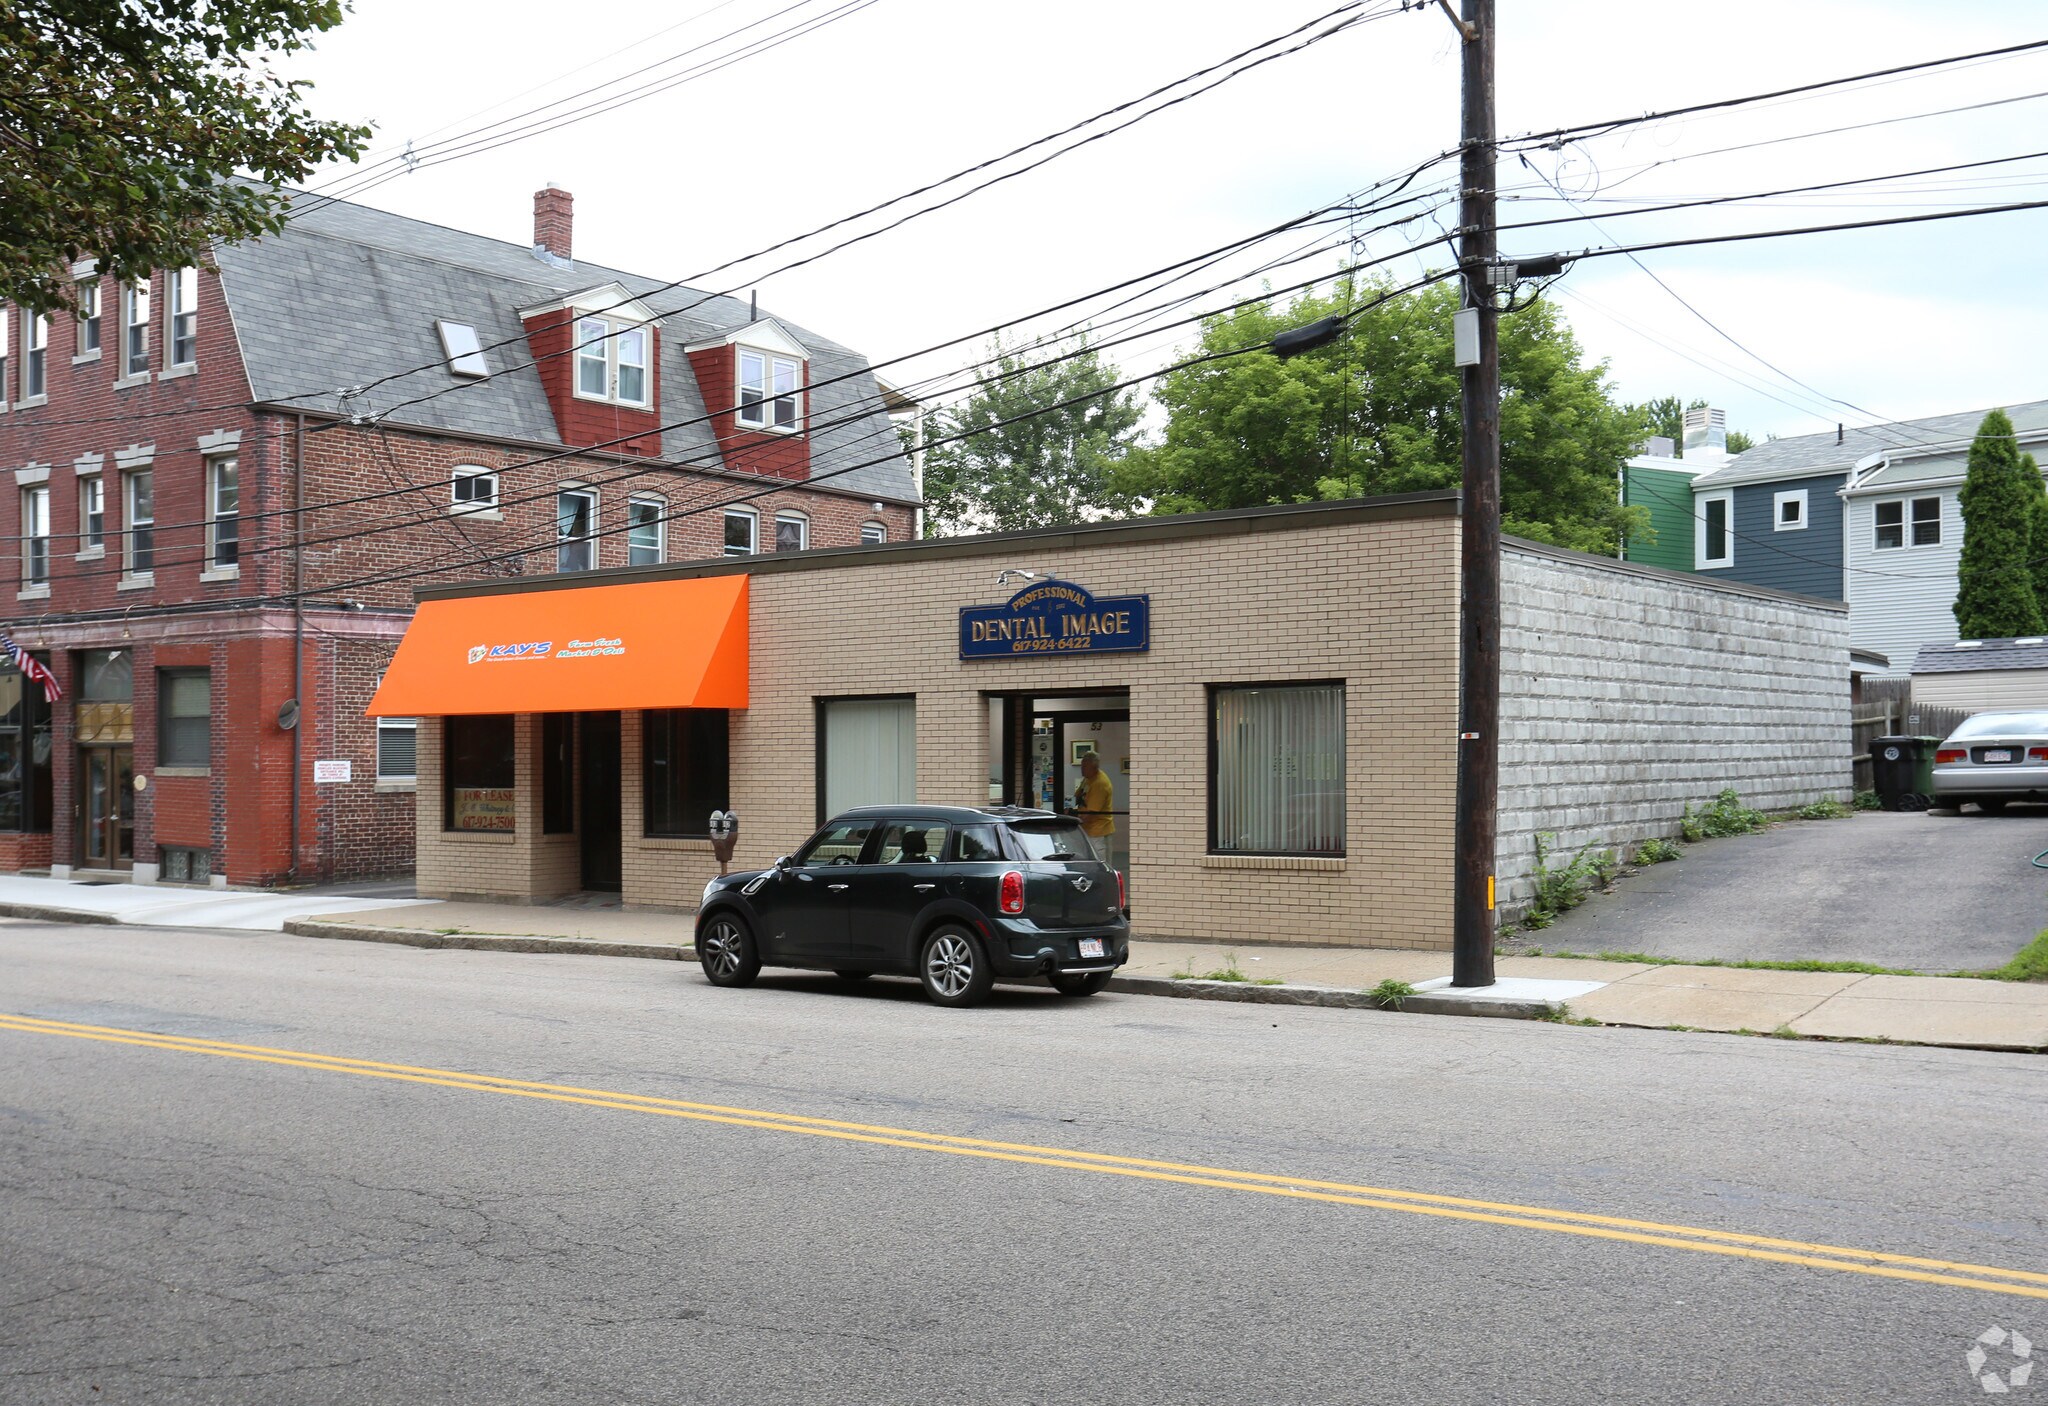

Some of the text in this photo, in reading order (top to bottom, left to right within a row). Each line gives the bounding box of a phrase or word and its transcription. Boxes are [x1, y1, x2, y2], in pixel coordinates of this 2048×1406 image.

[1012, 587, 1086, 612] PROFESSIONAL
[972, 611, 1130, 642] DENTAL IMAGE
[489, 642, 552, 656] KAY'S
[1090, 722, 1103, 731] 53
[464, 790, 515, 802] FOR LEASE
